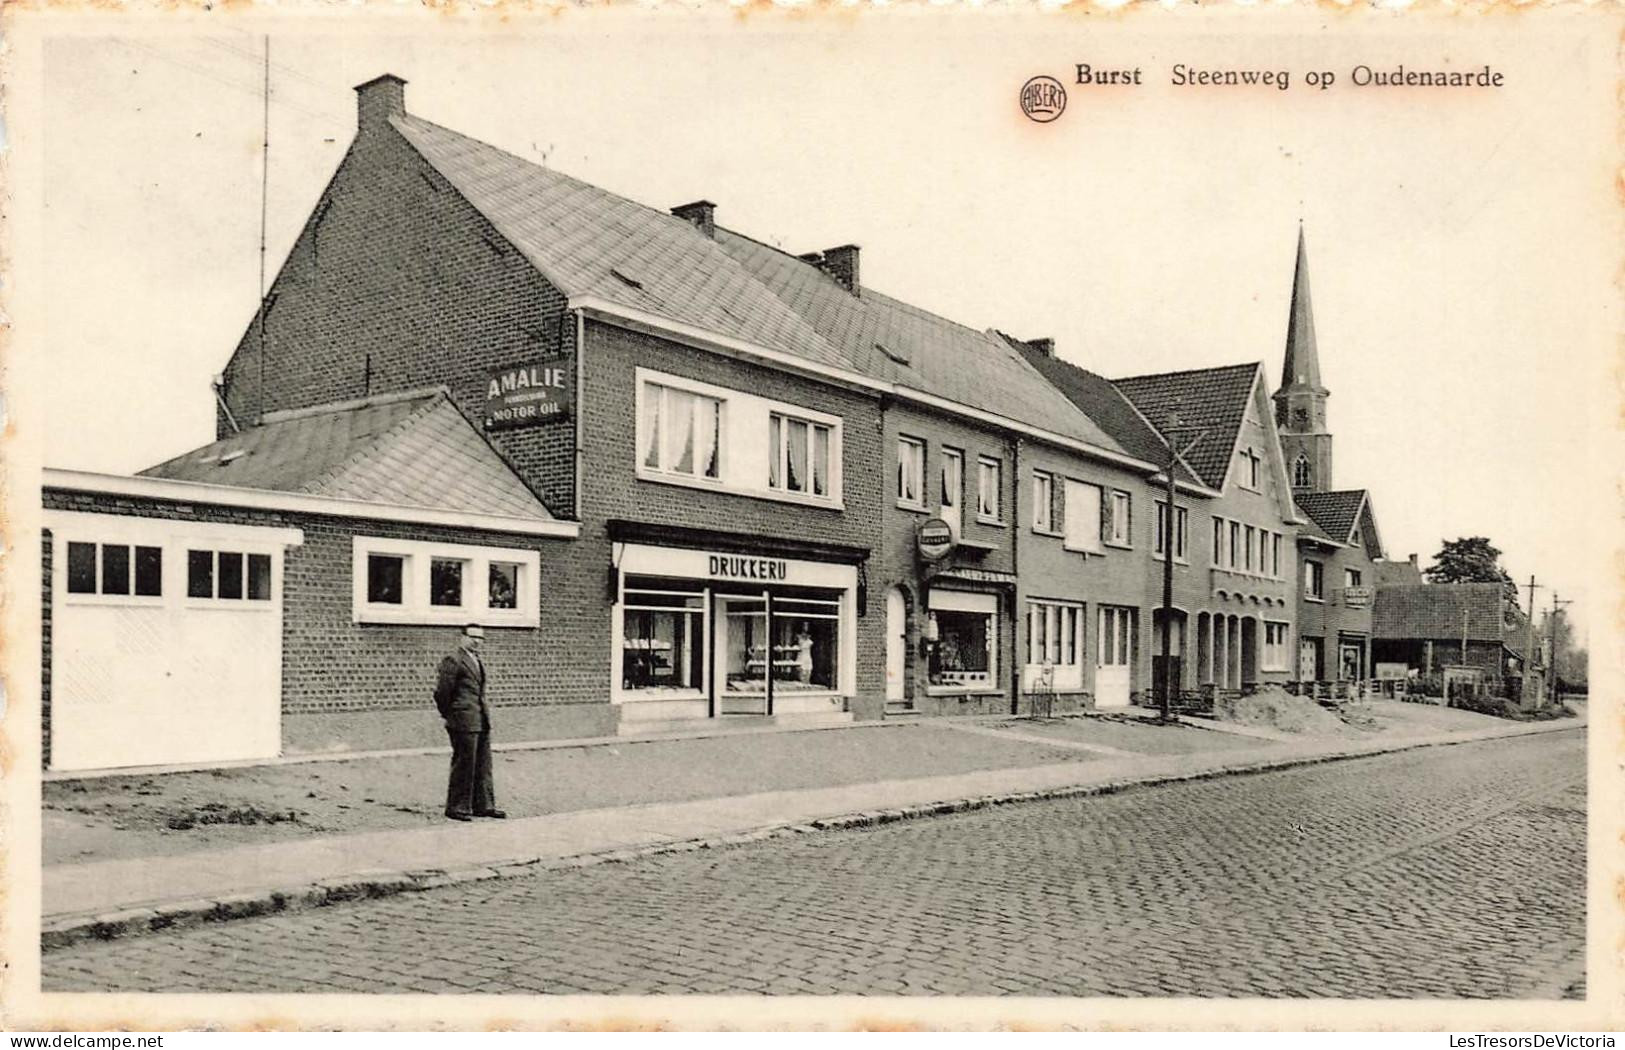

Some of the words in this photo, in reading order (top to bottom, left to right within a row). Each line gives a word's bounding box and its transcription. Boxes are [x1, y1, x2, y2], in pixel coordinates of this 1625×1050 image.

[487, 368, 566, 400] AMALIE
[493, 405, 536, 421] MOTOR
[540, 401, 561, 415] OIL
